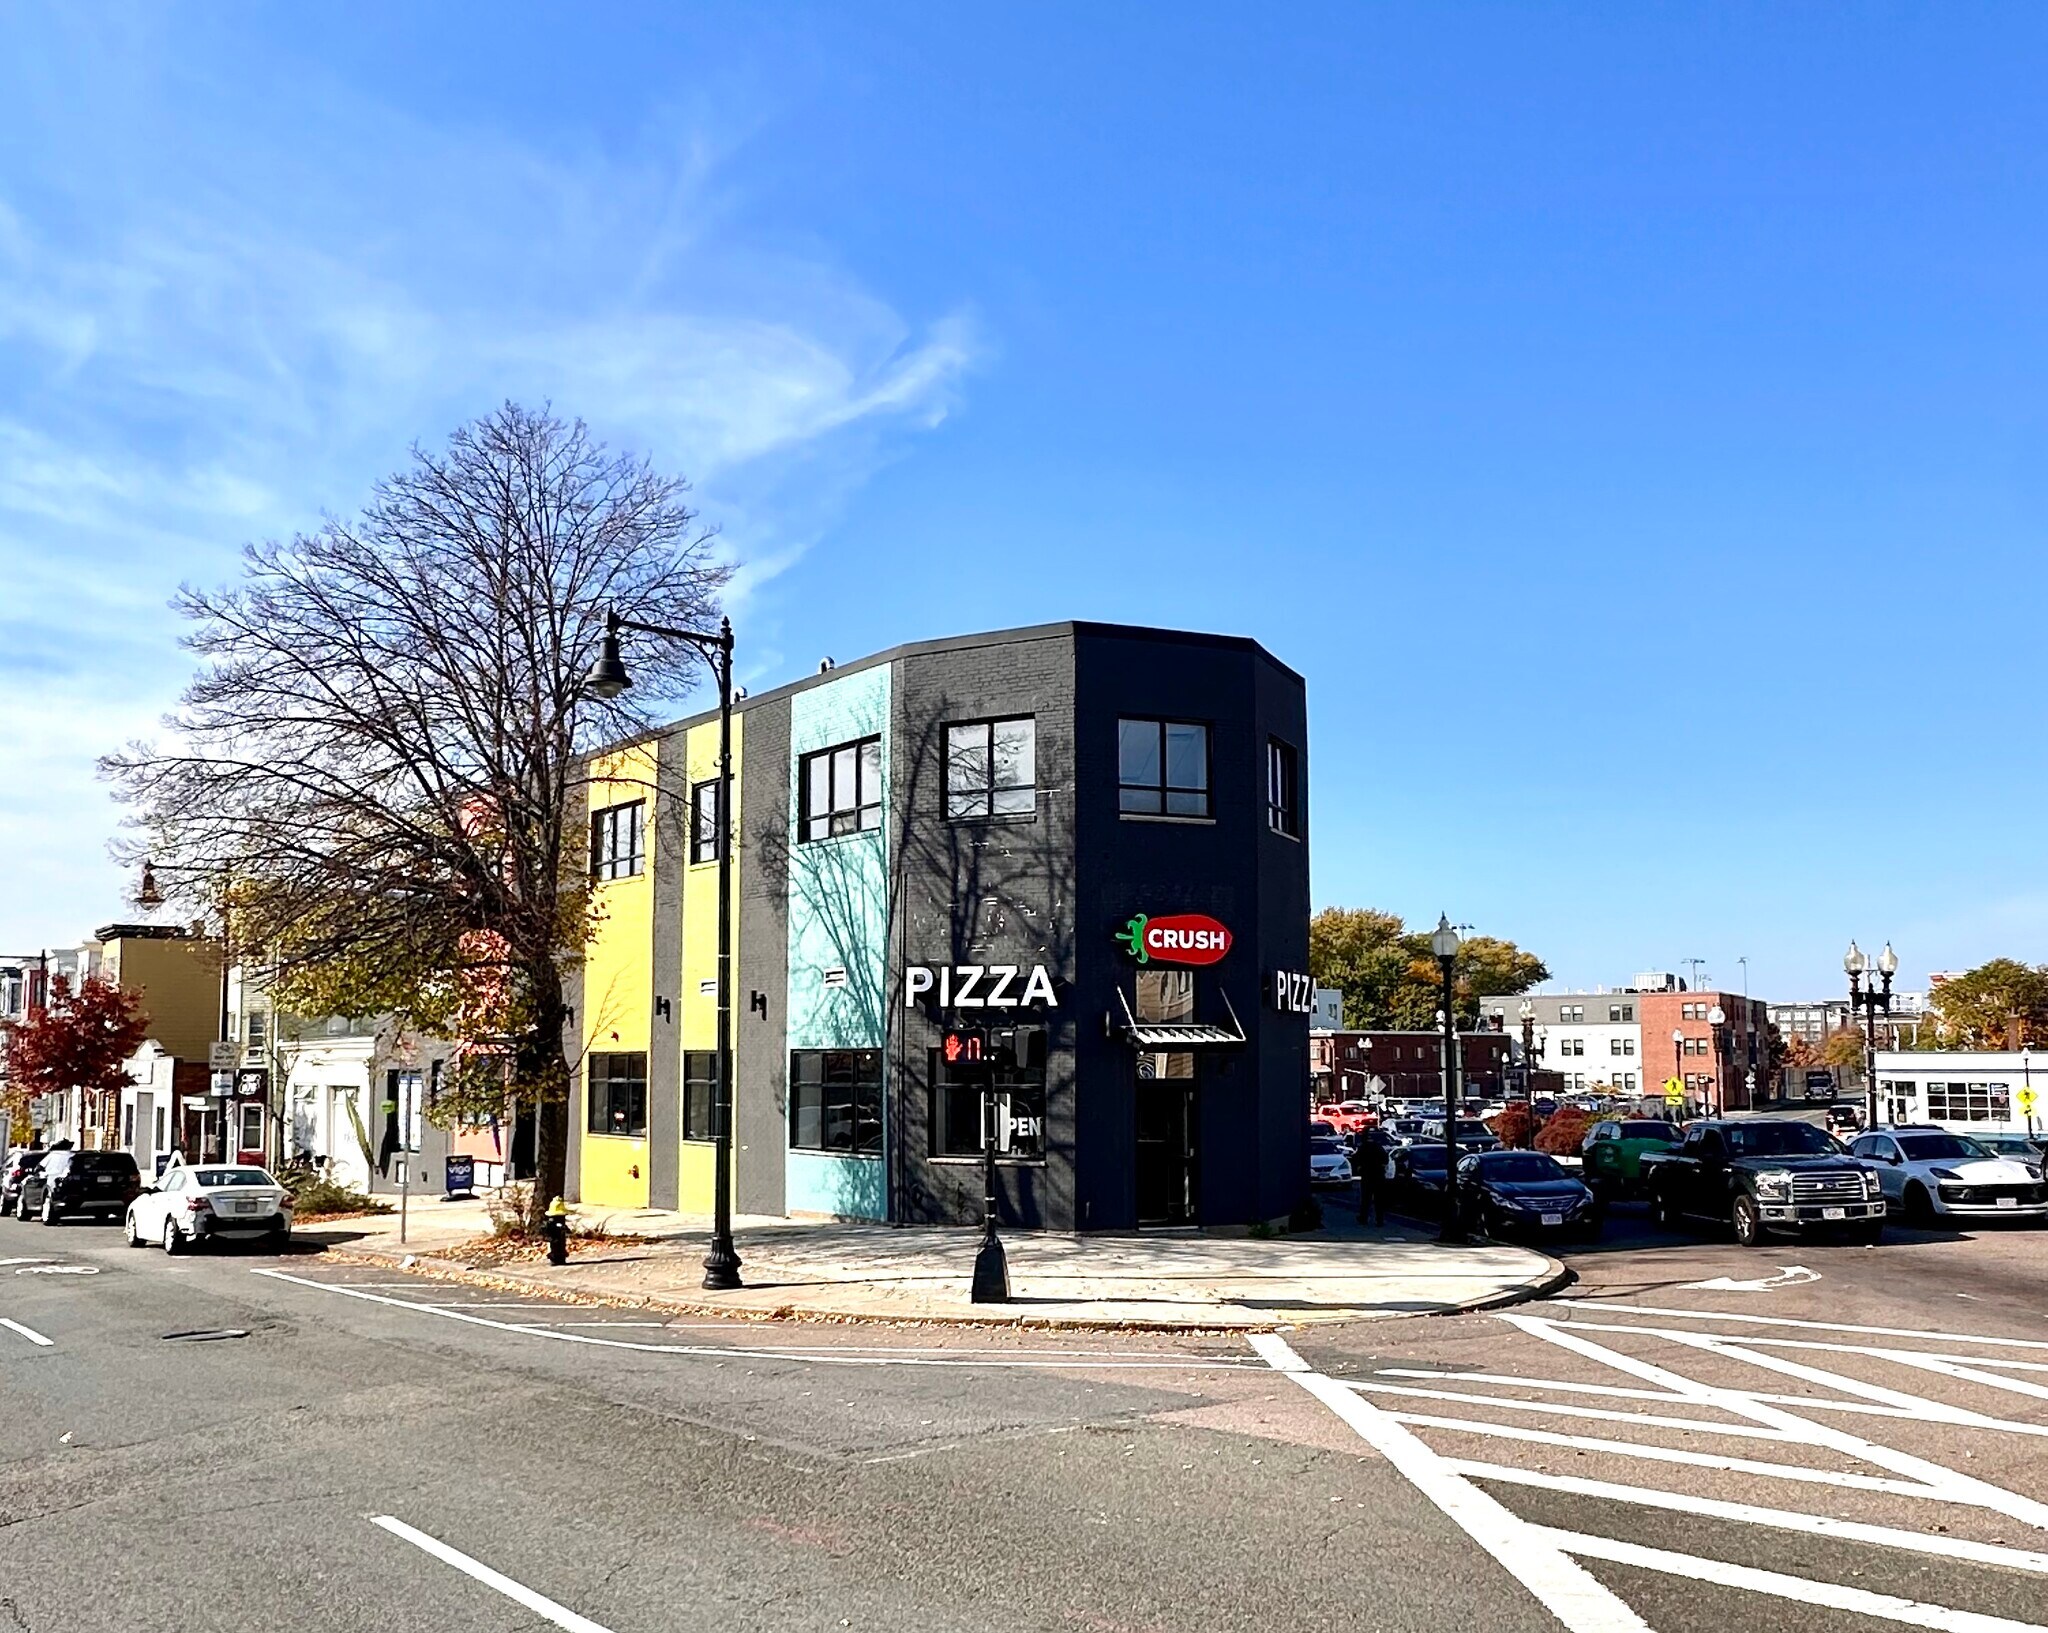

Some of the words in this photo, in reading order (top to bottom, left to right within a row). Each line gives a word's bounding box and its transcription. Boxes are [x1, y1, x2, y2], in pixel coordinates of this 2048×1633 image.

[1148, 928, 1225, 950] CRUSH
[905, 964, 1059, 1008] PIZZA
[1277, 970, 1319, 1015] PIZZA
[1008, 1116, 1042, 1137] PEN
